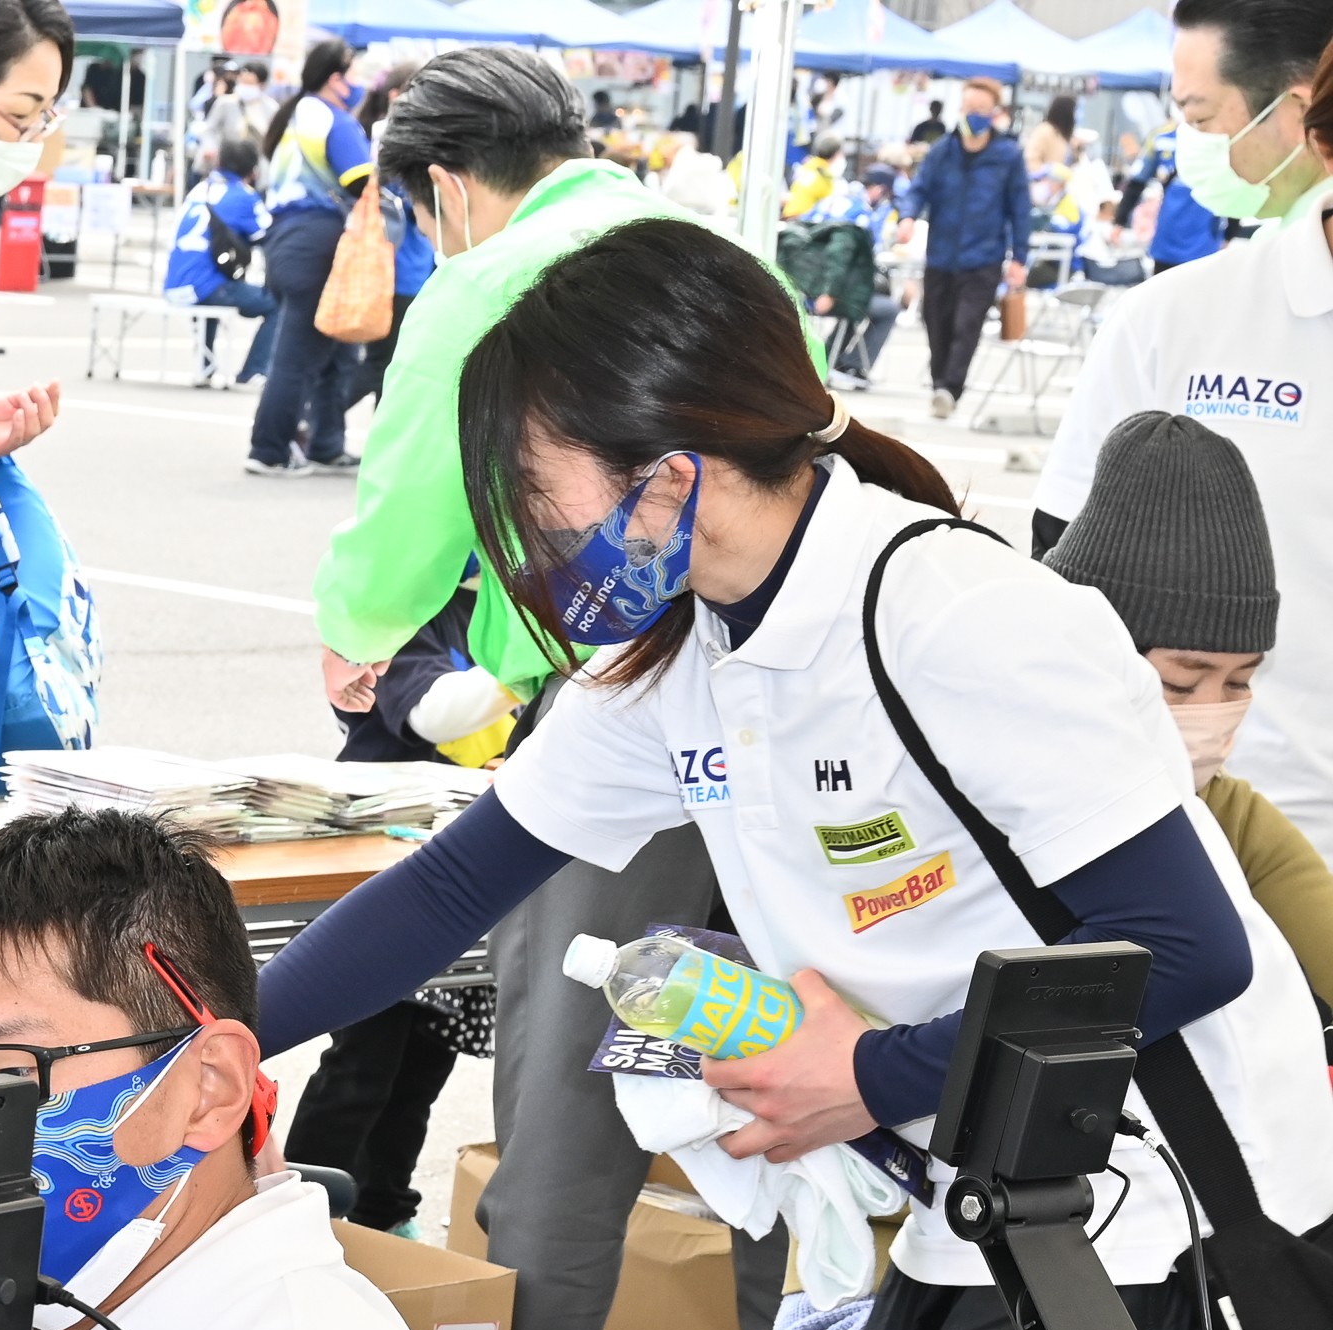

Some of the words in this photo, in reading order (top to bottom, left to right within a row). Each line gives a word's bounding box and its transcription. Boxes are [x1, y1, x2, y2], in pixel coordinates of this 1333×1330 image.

[1187, 374, 1302, 407] IMAZO
[1185, 402, 1250, 417] ROWING
[1256, 405, 1299, 423] TEAM
[562, 581, 593, 626] IMAZO
[815, 759, 853, 793] HH
[851, 863, 949, 922] PowerBar
